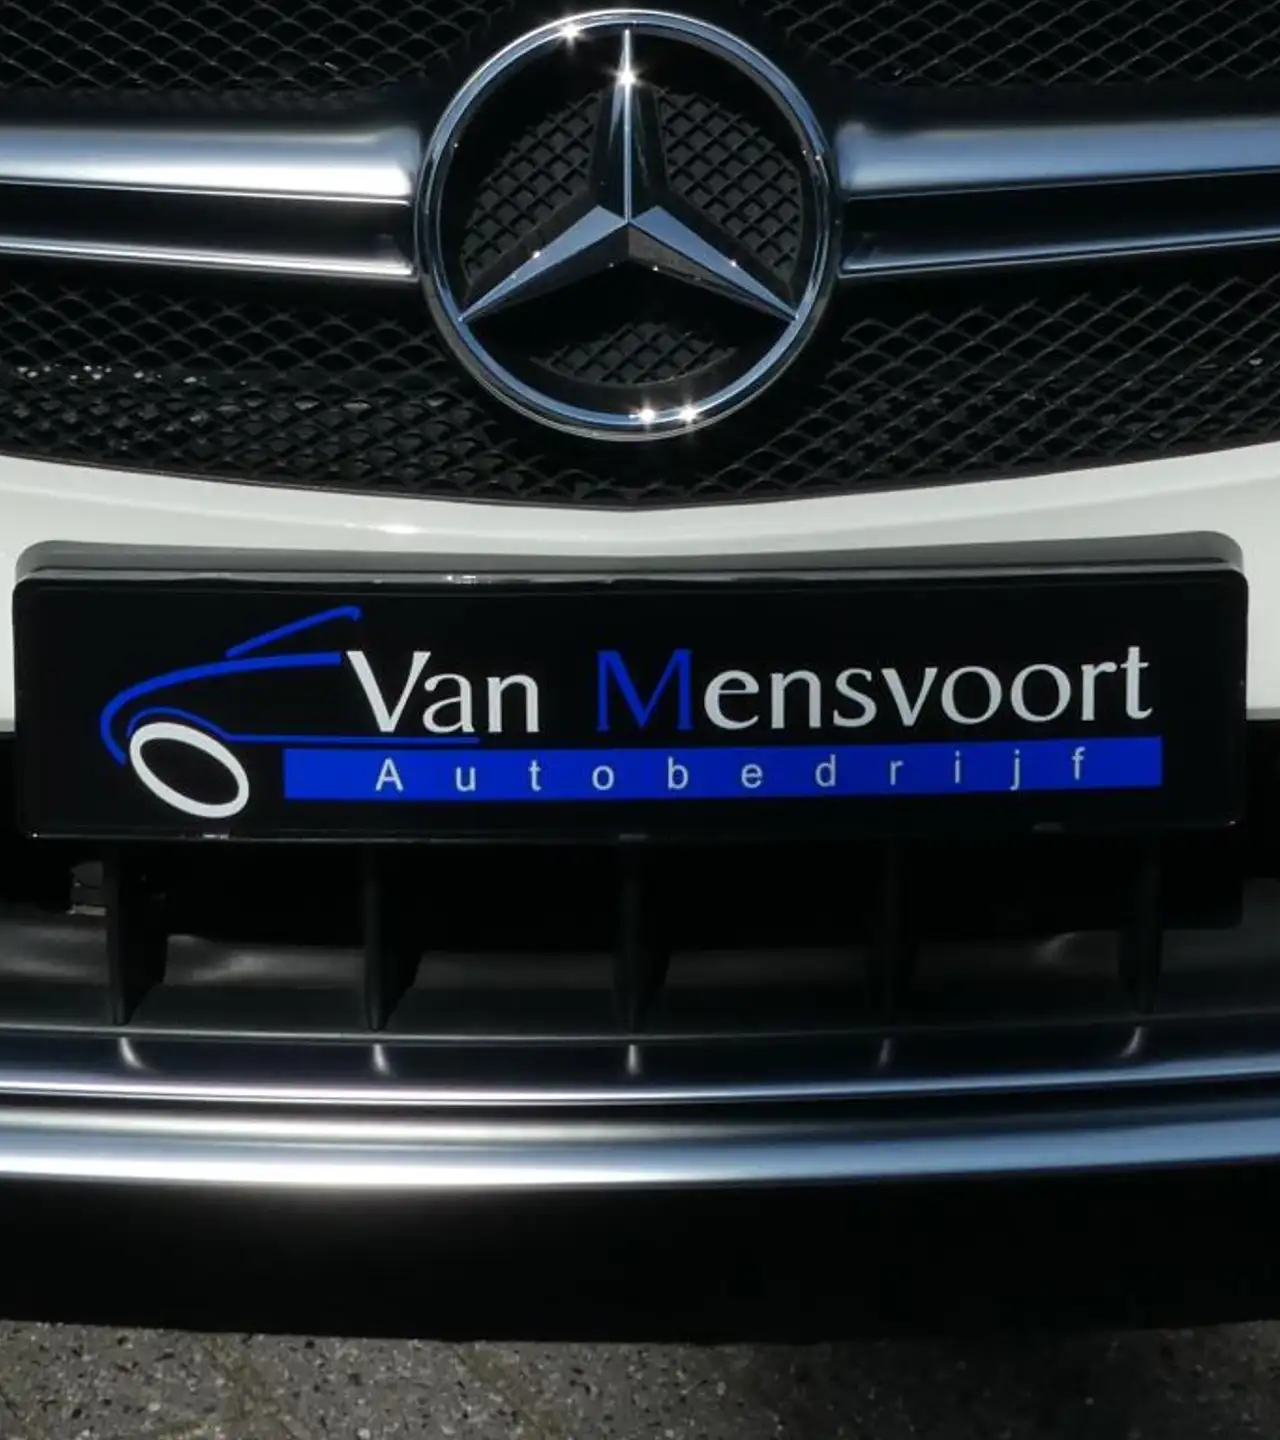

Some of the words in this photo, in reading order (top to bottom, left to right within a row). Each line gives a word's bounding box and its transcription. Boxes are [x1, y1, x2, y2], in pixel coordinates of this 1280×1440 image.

[347, 648, 540, 734] Van
[596, 644, 1152, 734] Mensvoort
[375, 746, 1086, 792] Autobedrijf
